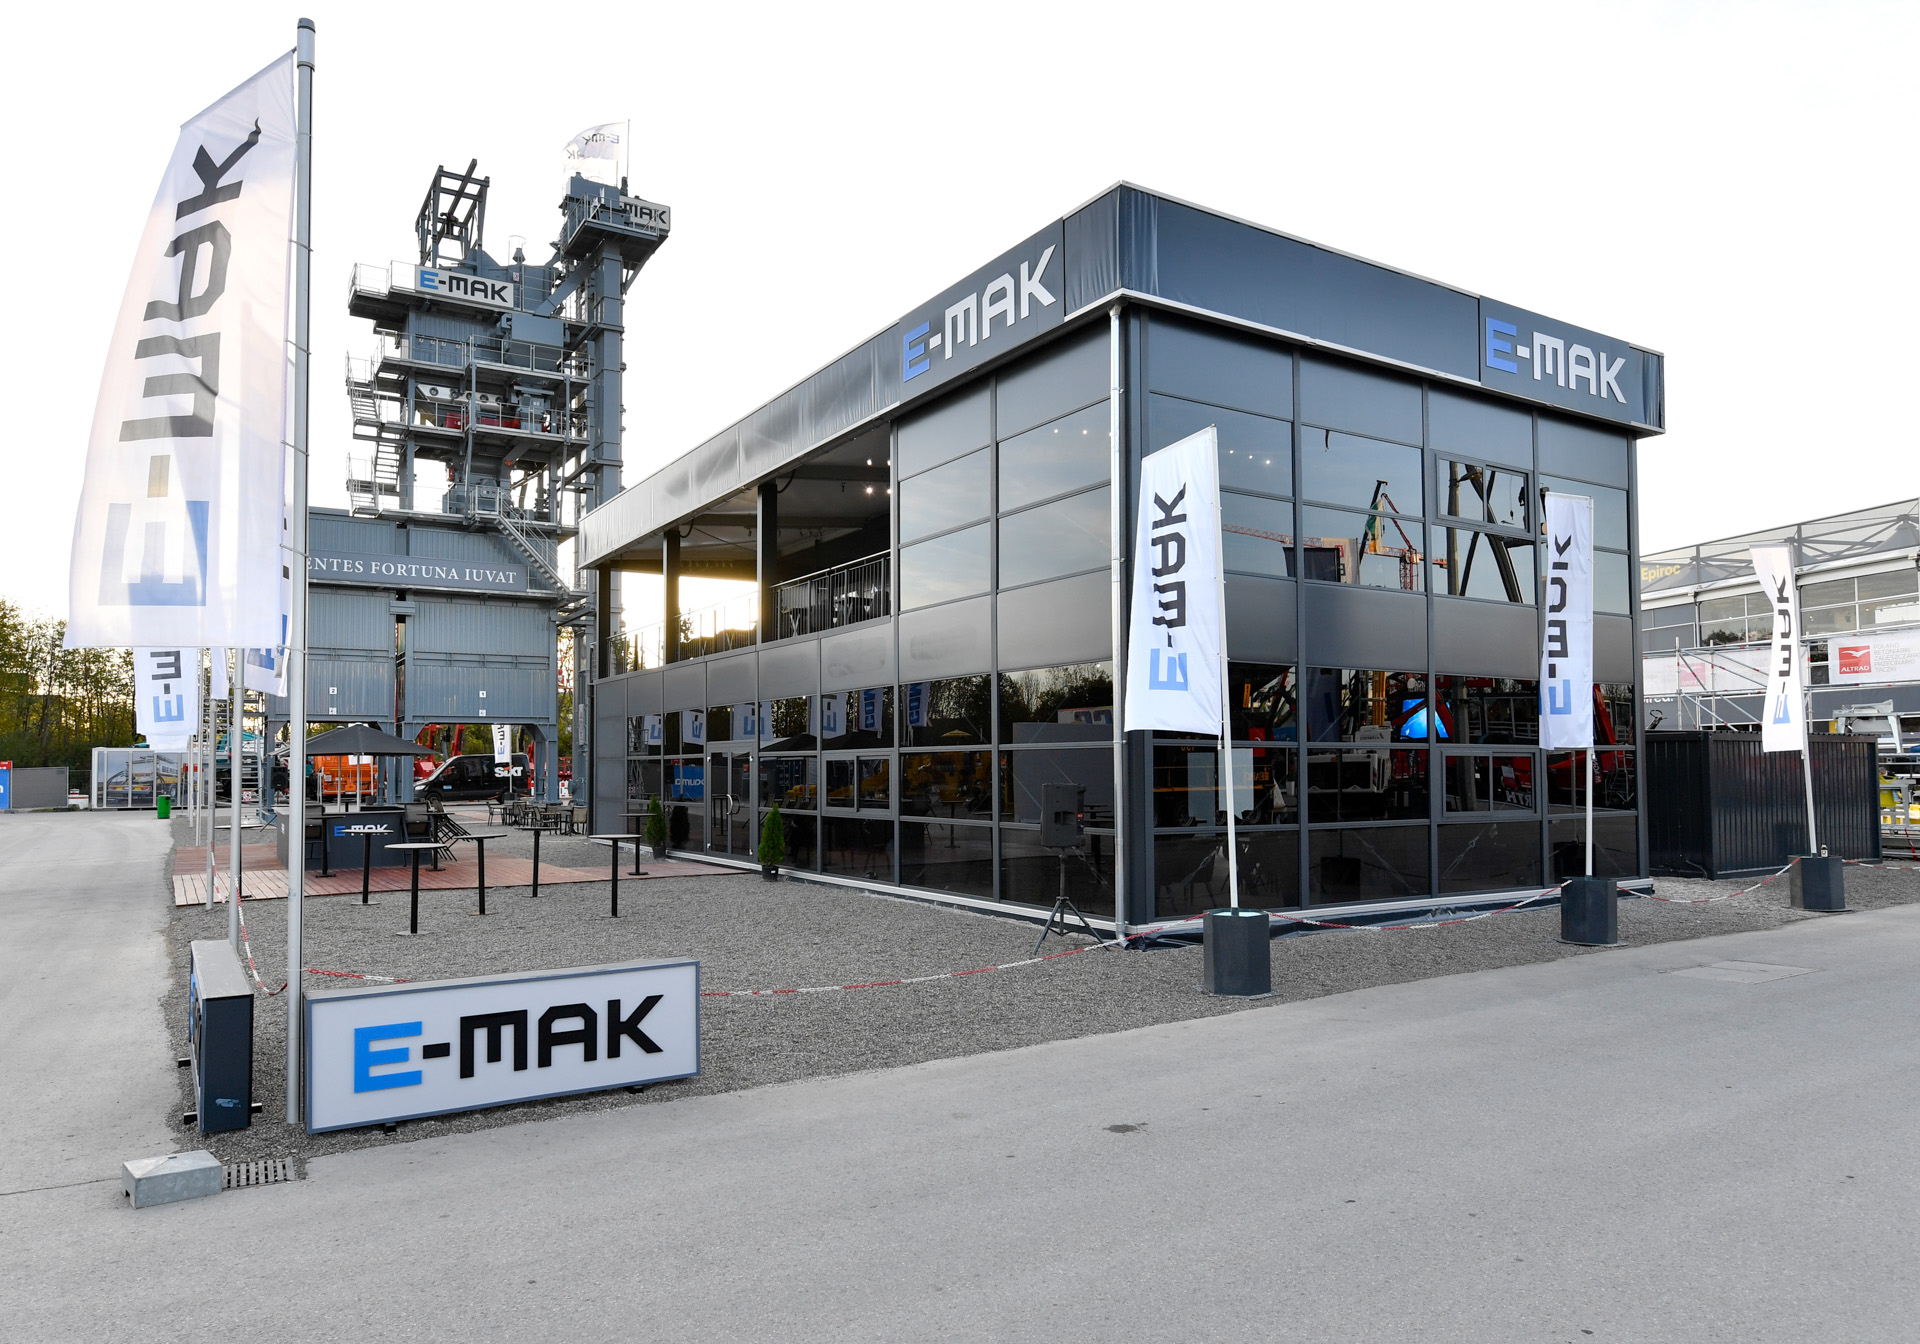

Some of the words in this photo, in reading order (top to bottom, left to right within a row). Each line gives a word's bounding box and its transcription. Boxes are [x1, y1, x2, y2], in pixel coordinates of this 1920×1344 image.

[420, 269, 509, 304] E-MAK
[904, 244, 1057, 383] E-MAK
[98, 117, 261, 607] E-MAK
[1486, 316, 1627, 405] E-MAK
[371, 561, 460, 580] FORTUNA
[465, 568, 517, 585] IUVAT
[1149, 481, 1188, 692] E-MAK
[1641, 564, 1681, 582] Epiroc
[353, 994, 664, 1094] E-MAK
